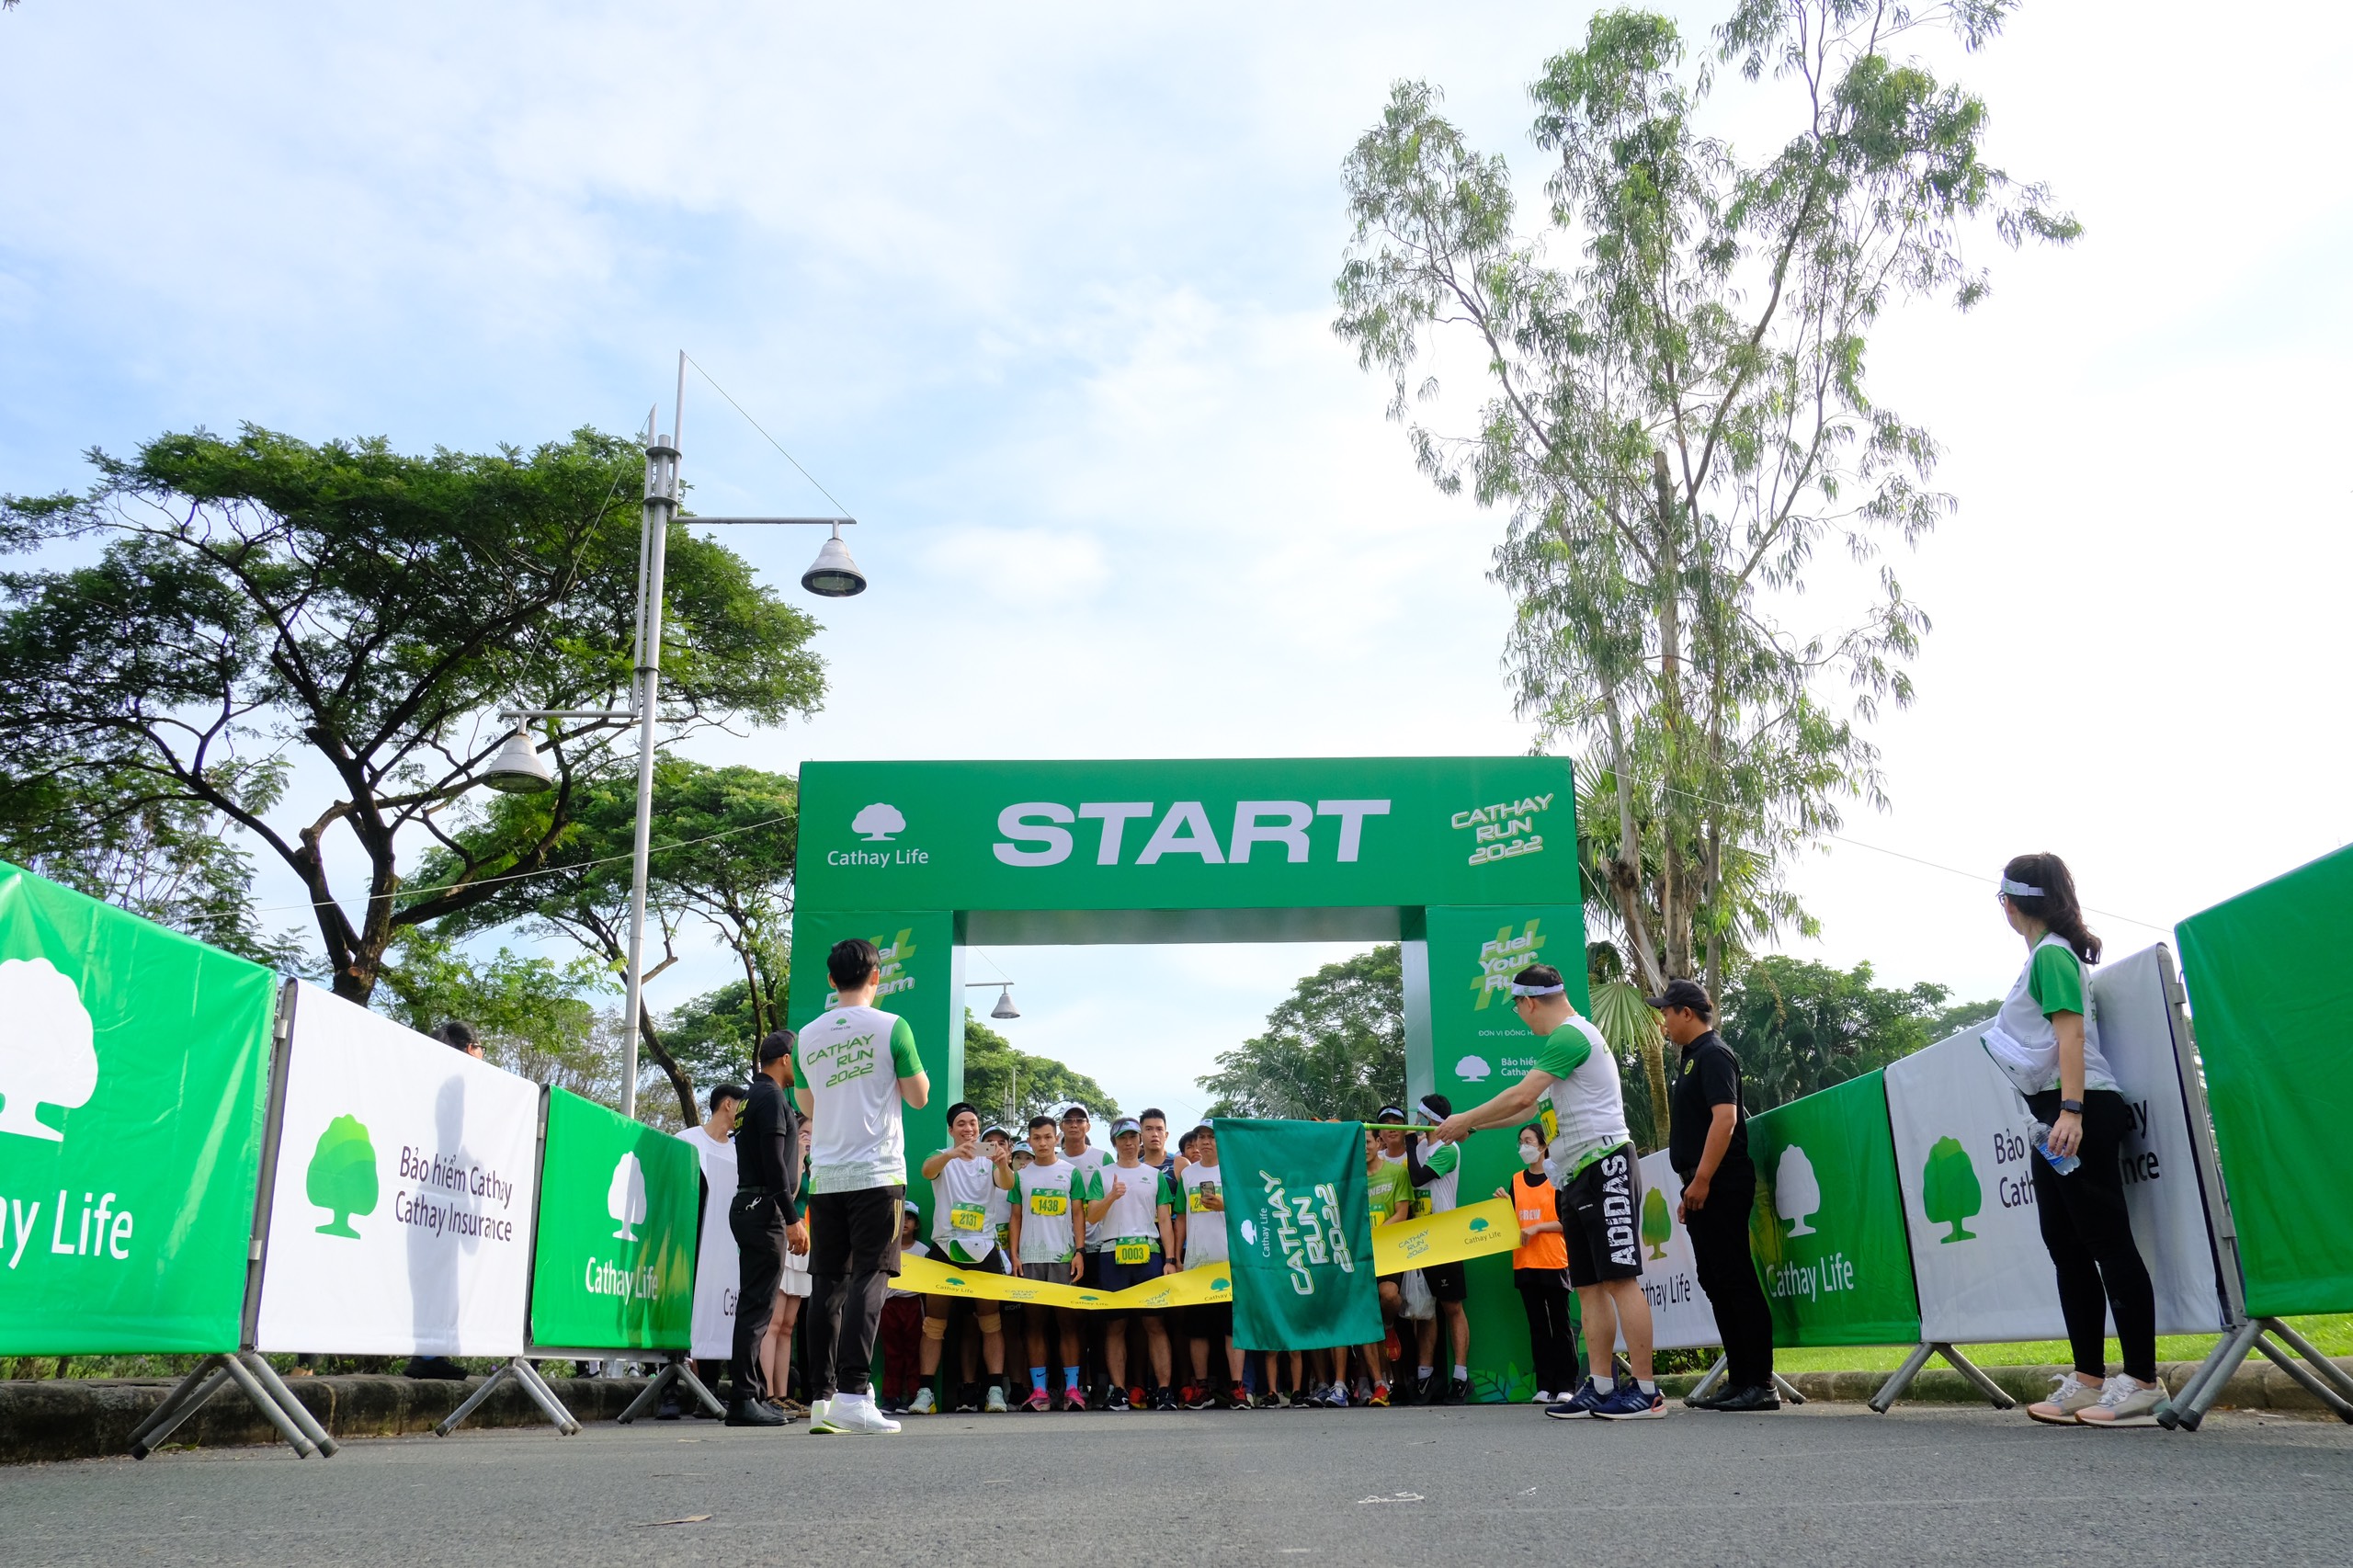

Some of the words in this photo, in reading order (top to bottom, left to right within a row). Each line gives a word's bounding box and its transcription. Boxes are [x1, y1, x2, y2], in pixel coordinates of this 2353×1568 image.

[1451, 792, 1553, 829] CATHAY
[993, 799, 1391, 867] START
[1476, 816, 1532, 844] RUN
[827, 850, 891, 869] Cathay
[896, 848, 929, 864] Life
[1469, 835, 1544, 867] 2022
[1481, 931, 1533, 959] Fuel
[1479, 950, 1539, 976] Your
[1484, 973, 1518, 994] Ru
[806, 1033, 875, 1065] CATHAY
[836, 1048, 874, 1068] RUN
[826, 1062, 874, 1088] 2022
[1994, 1127, 2025, 1165] Bảo
[400, 1145, 429, 1183] Bảo
[432, 1153, 466, 1193] hiểm
[470, 1165, 513, 1210] Cathay
[395, 1190, 447, 1239] Cathay
[959, 1212, 977, 1227] 2131
[1039, 1199, 1059, 1212] 1438
[1259, 1207, 1268, 1224] Life
[1600, 1153, 1638, 1267] ADIDAS
[51, 1189, 133, 1260] Life
[1258, 1169, 1314, 1295] CATHAY
[1291, 1197, 1330, 1265] RUN
[1314, 1182, 1355, 1274] 2022
[1398, 1229, 1429, 1249] CATHAY
[1464, 1233, 1488, 1245] Cathay
[1489, 1230, 1502, 1239] Life
[1122, 1247, 1144, 1260] 0003
[1262, 1226, 1270, 1258] Cathay
[1406, 1244, 1429, 1259] 2022
[1407, 1238, 1425, 1252] RUN
[585, 1256, 634, 1306] Cathay
[635, 1266, 659, 1301] Life
[936, 1284, 960, 1293] Cathay
[961, 1286, 974, 1294] Life
[1641, 1278, 1666, 1312] thay
[1670, 1273, 1691, 1303] Life
[1766, 1259, 1816, 1303] Cathay
[1821, 1252, 1854, 1292] Life
